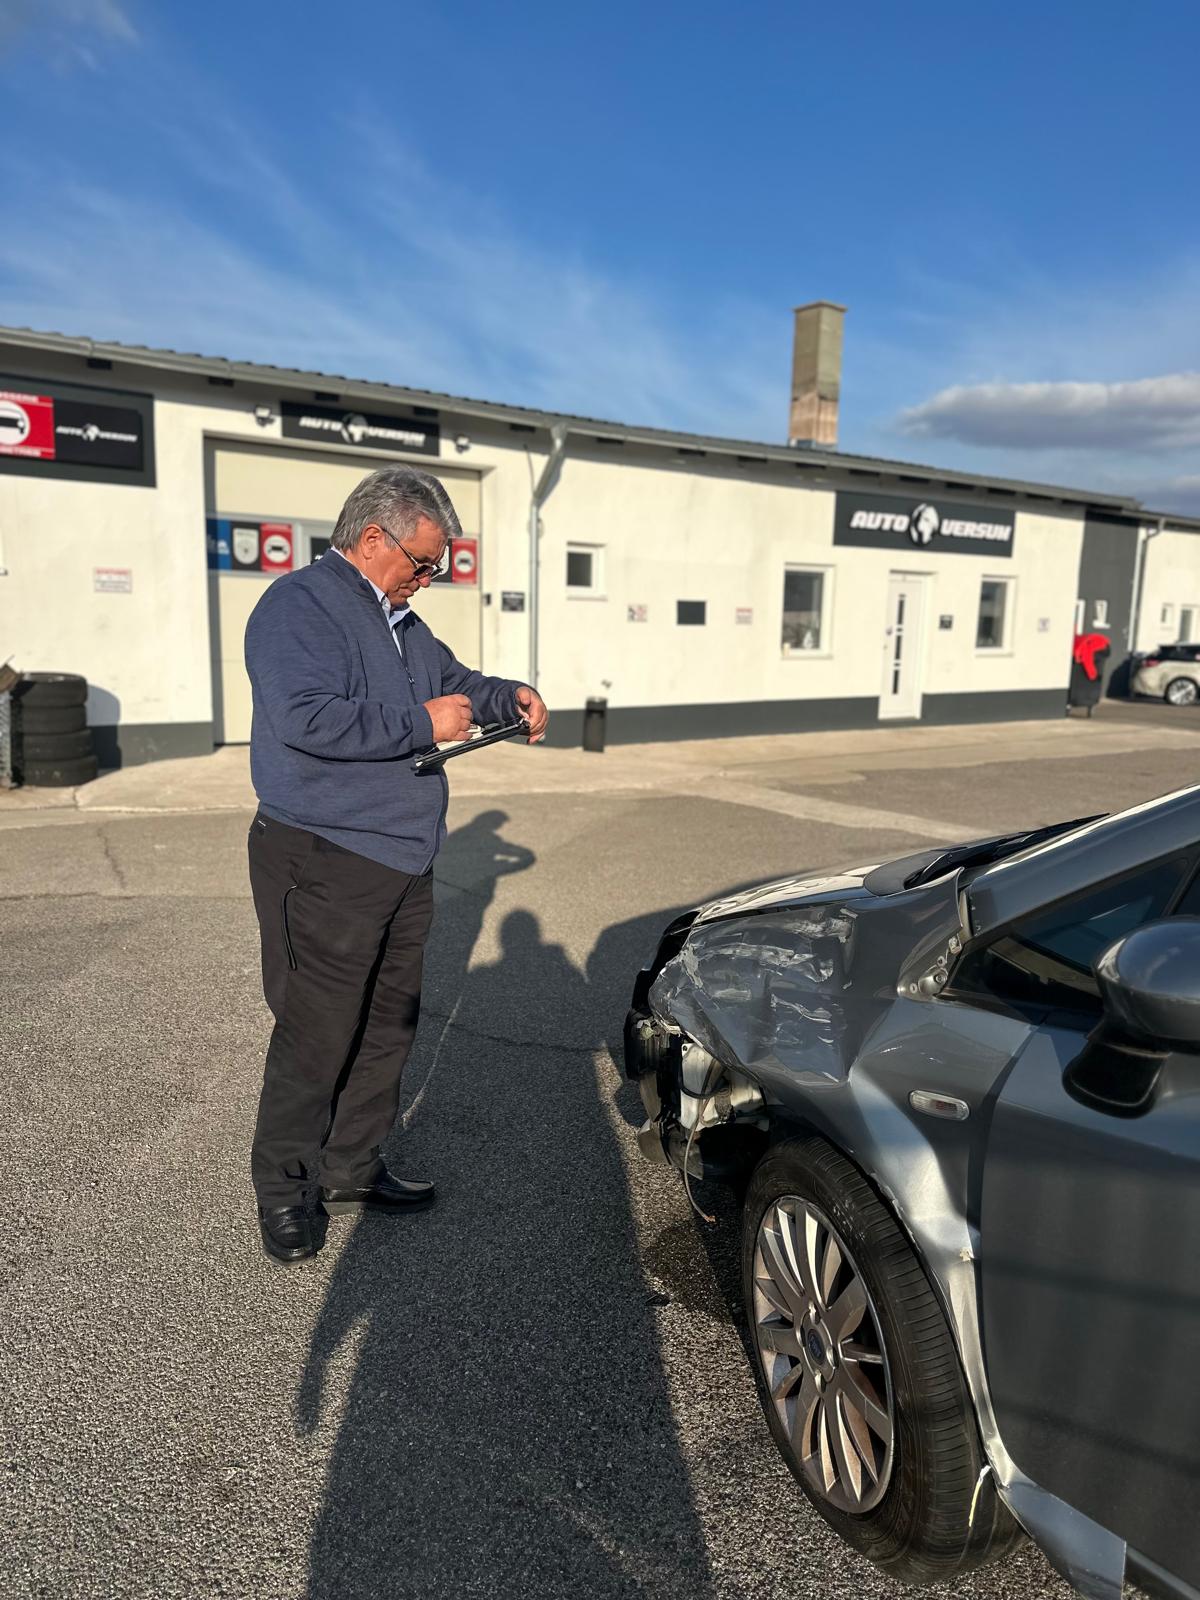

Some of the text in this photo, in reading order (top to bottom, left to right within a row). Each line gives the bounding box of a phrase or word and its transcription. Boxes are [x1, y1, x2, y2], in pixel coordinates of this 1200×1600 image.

[299, 416, 342, 431] AUTO
[850, 510, 1011, 541] AUTO VERSUM
